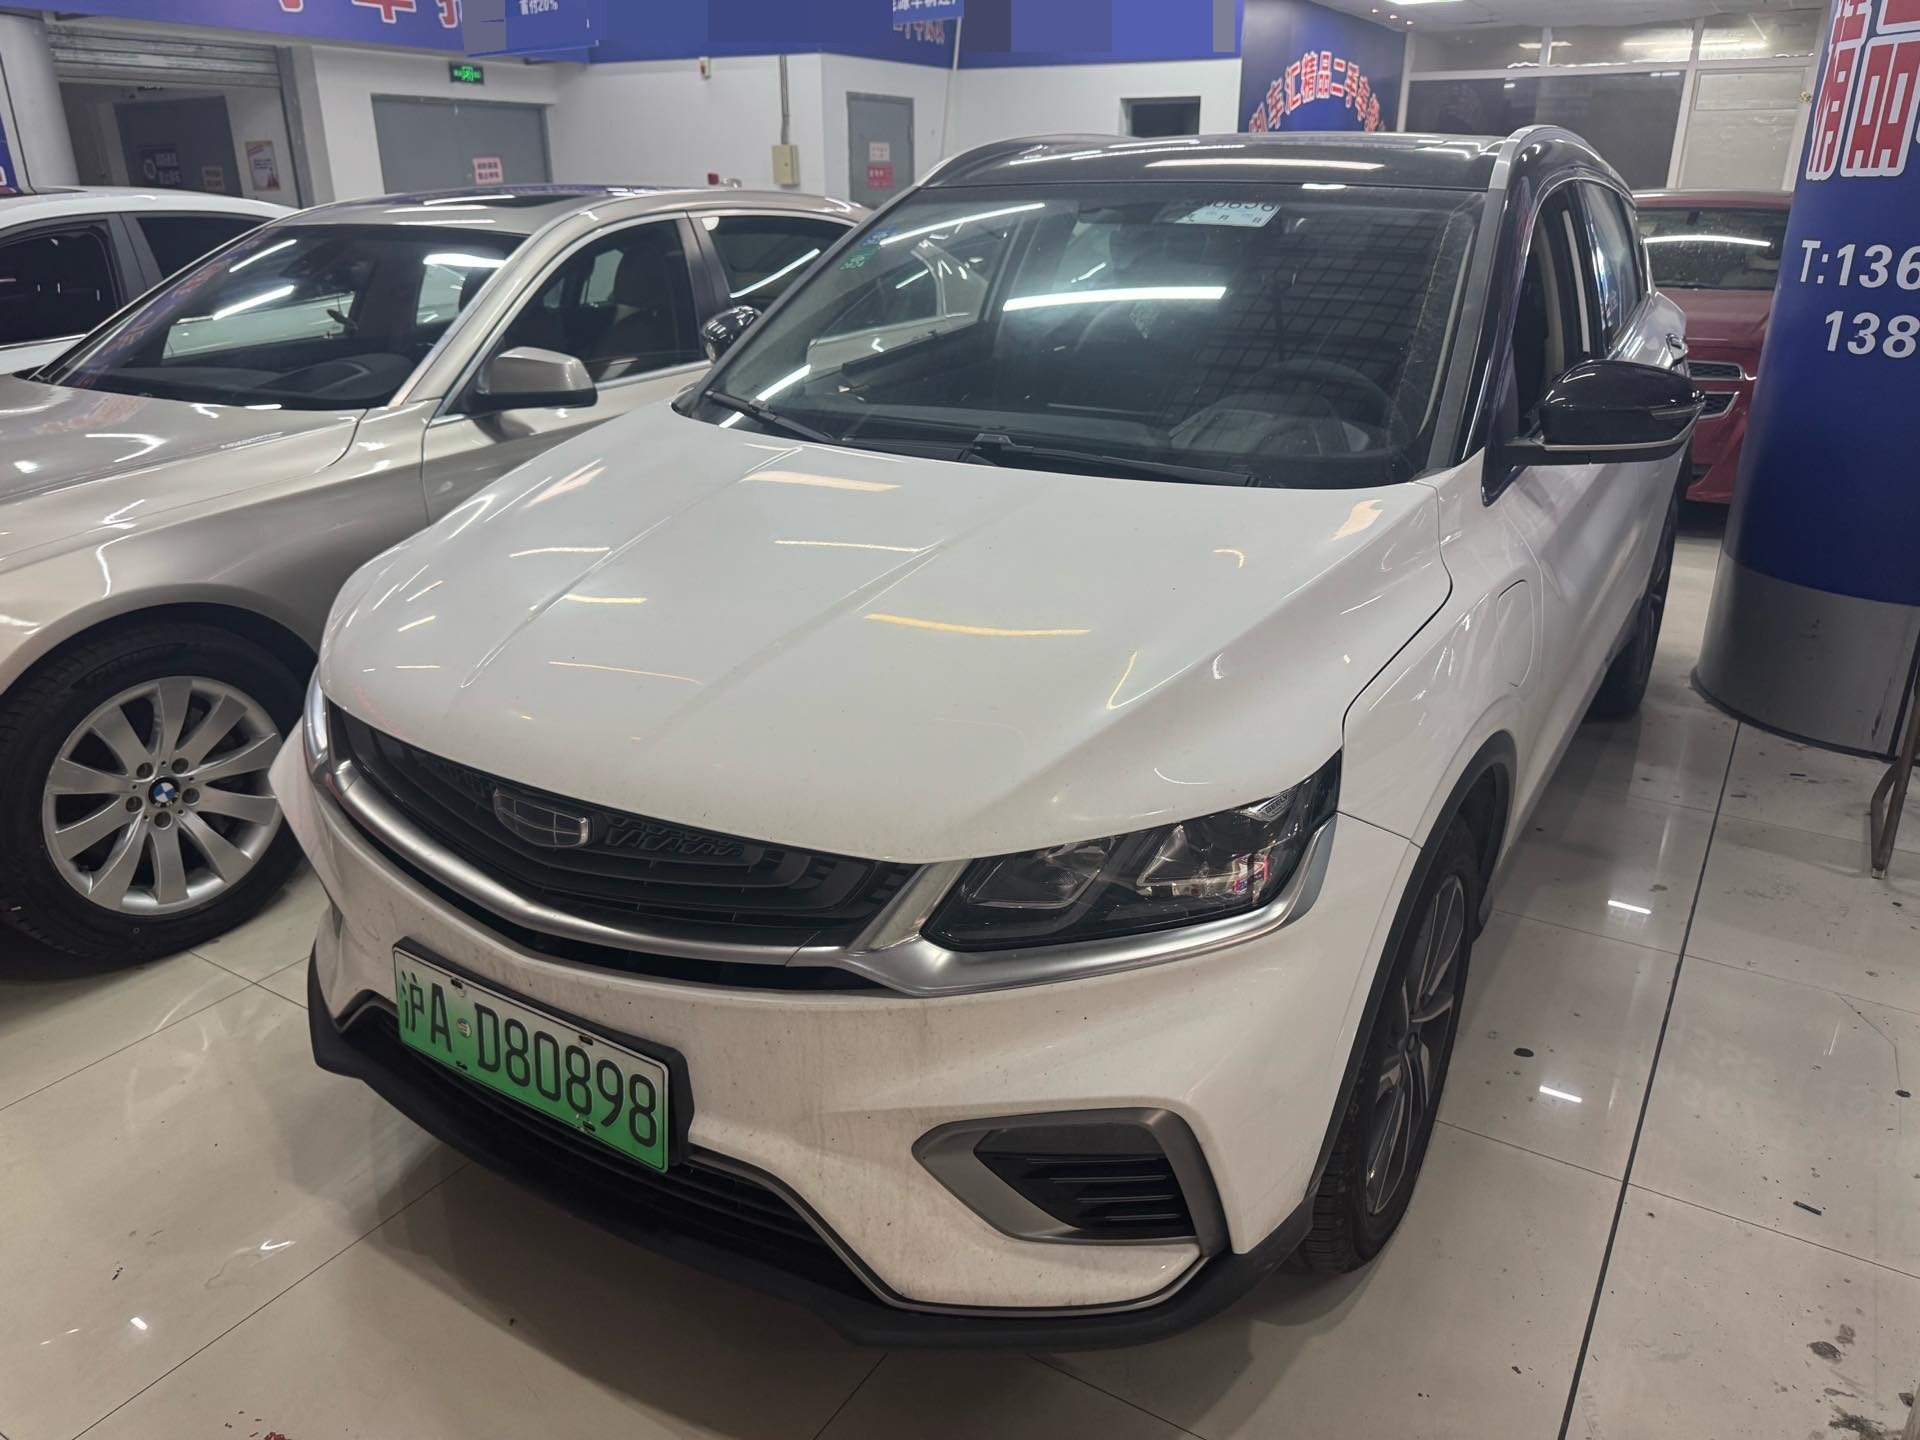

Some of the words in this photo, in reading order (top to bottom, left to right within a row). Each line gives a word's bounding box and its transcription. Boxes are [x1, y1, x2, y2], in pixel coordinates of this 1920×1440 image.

[1249, 51, 1387, 132] 车汇精品二手车
[1825, 310, 1920, 359] 138
